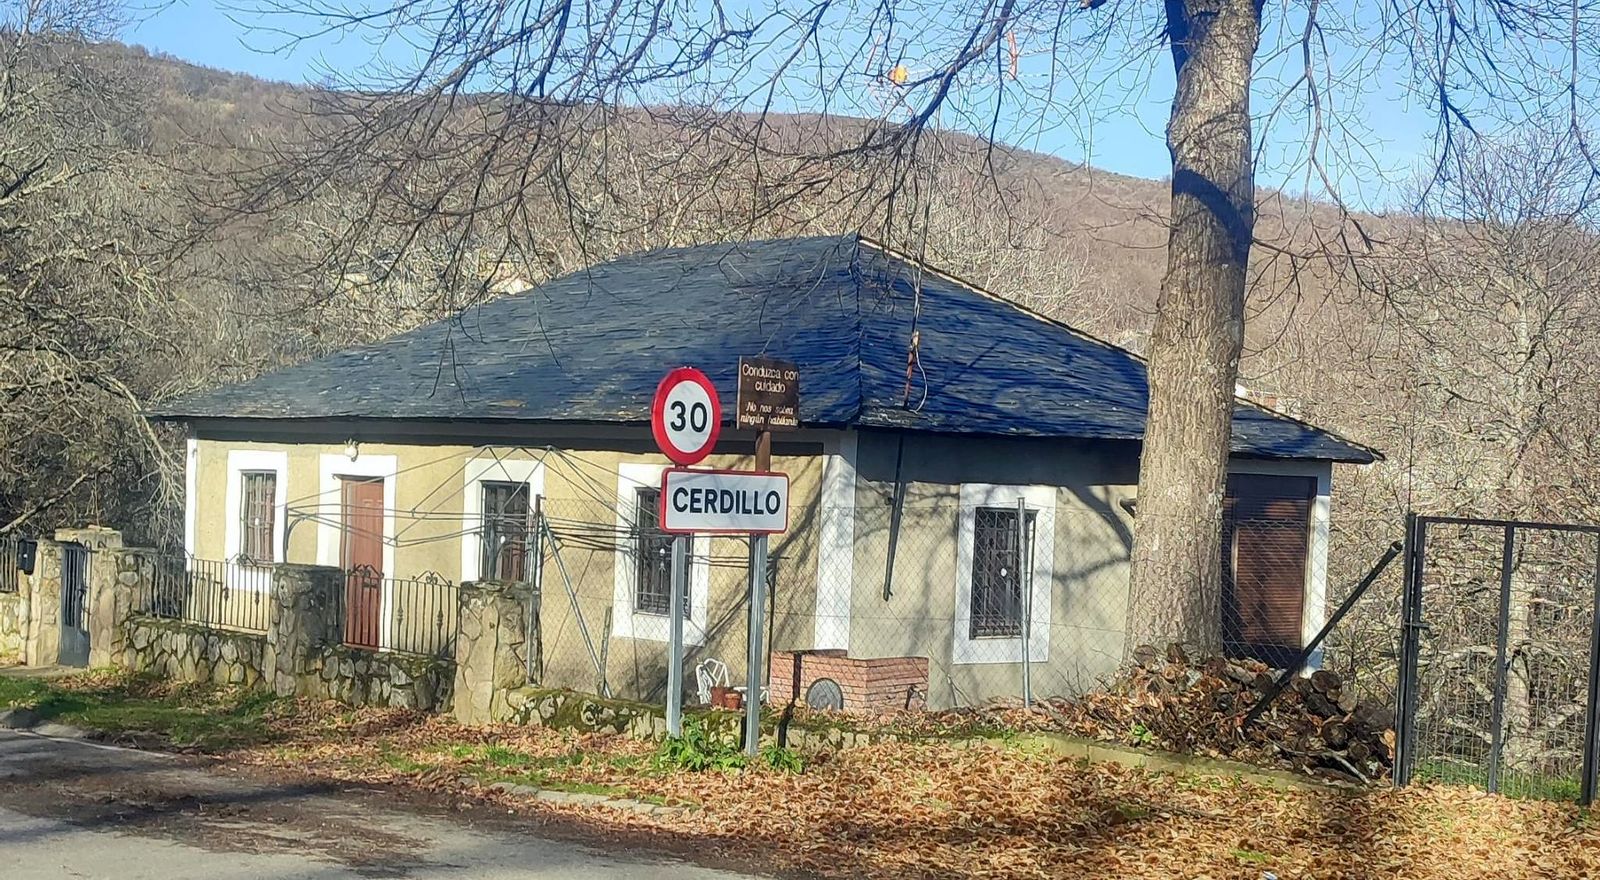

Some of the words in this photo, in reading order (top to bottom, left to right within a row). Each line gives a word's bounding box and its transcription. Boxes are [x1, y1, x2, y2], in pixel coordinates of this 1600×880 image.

[742, 363, 781, 379] Conduzca
[784, 370, 799, 381] con
[754, 379, 786, 393] cuidado
[670, 400, 708, 433] 30
[759, 404, 772, 413] nos
[740, 413, 765, 426] ningún
[672, 487, 781, 515] CERDILLO
